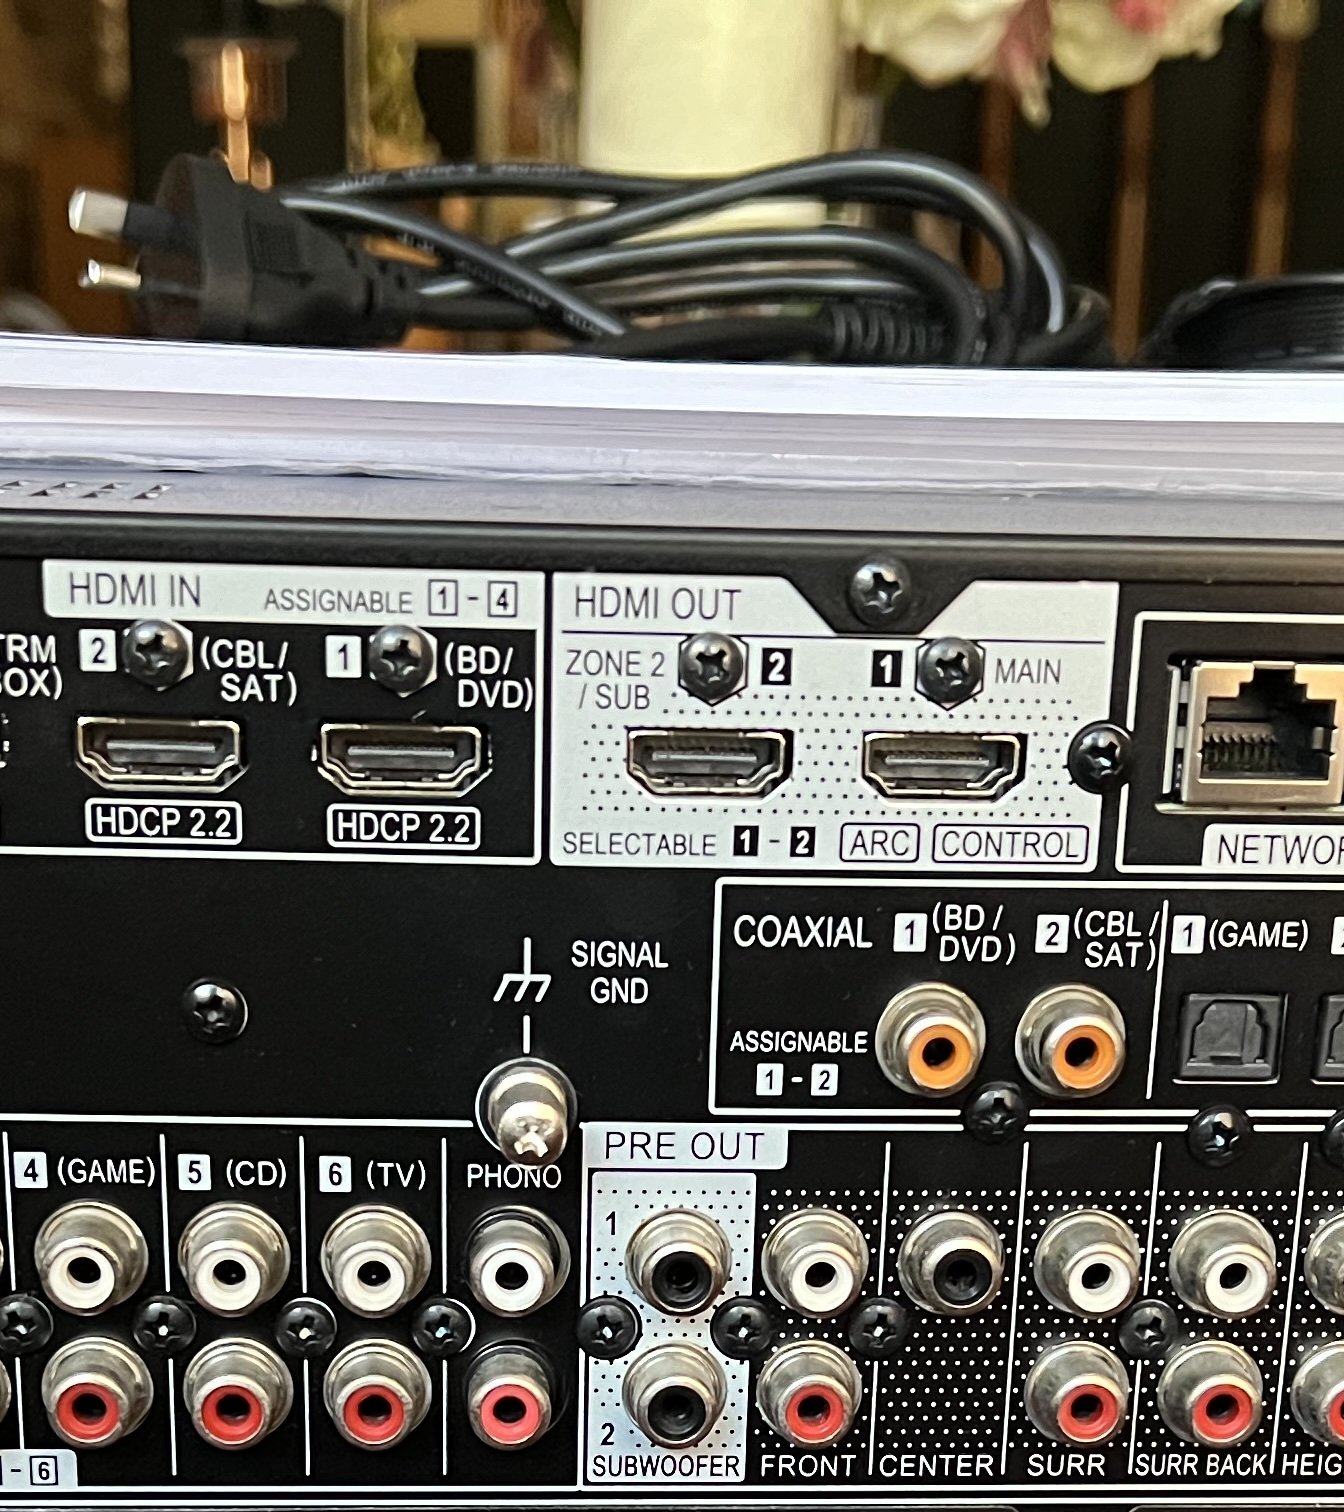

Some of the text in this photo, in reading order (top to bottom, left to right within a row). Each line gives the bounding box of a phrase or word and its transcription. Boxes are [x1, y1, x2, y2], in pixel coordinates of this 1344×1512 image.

[70, 572, 413, 614] HDMI IN ASSIGNABLE
[576, 586, 741, 620] HDMI OUT
[995, 658, 1061, 684] MAIN
[338, 812, 469, 842] HDCP 2.2
[563, 832, 716, 856] SELECTABLE
[850, 830, 909, 856] ARC
[942, 831, 1078, 857] CONTROL
[734, 915, 872, 948] COAXIAL
[572, 940, 668, 968] SIGNAL
[591, 977, 648, 1003] GND
[606, 1132, 764, 1160] PRE OUT
[468, 1163, 561, 1188] PHONO
[593, 1455, 739, 1476] SUBWOOFER
